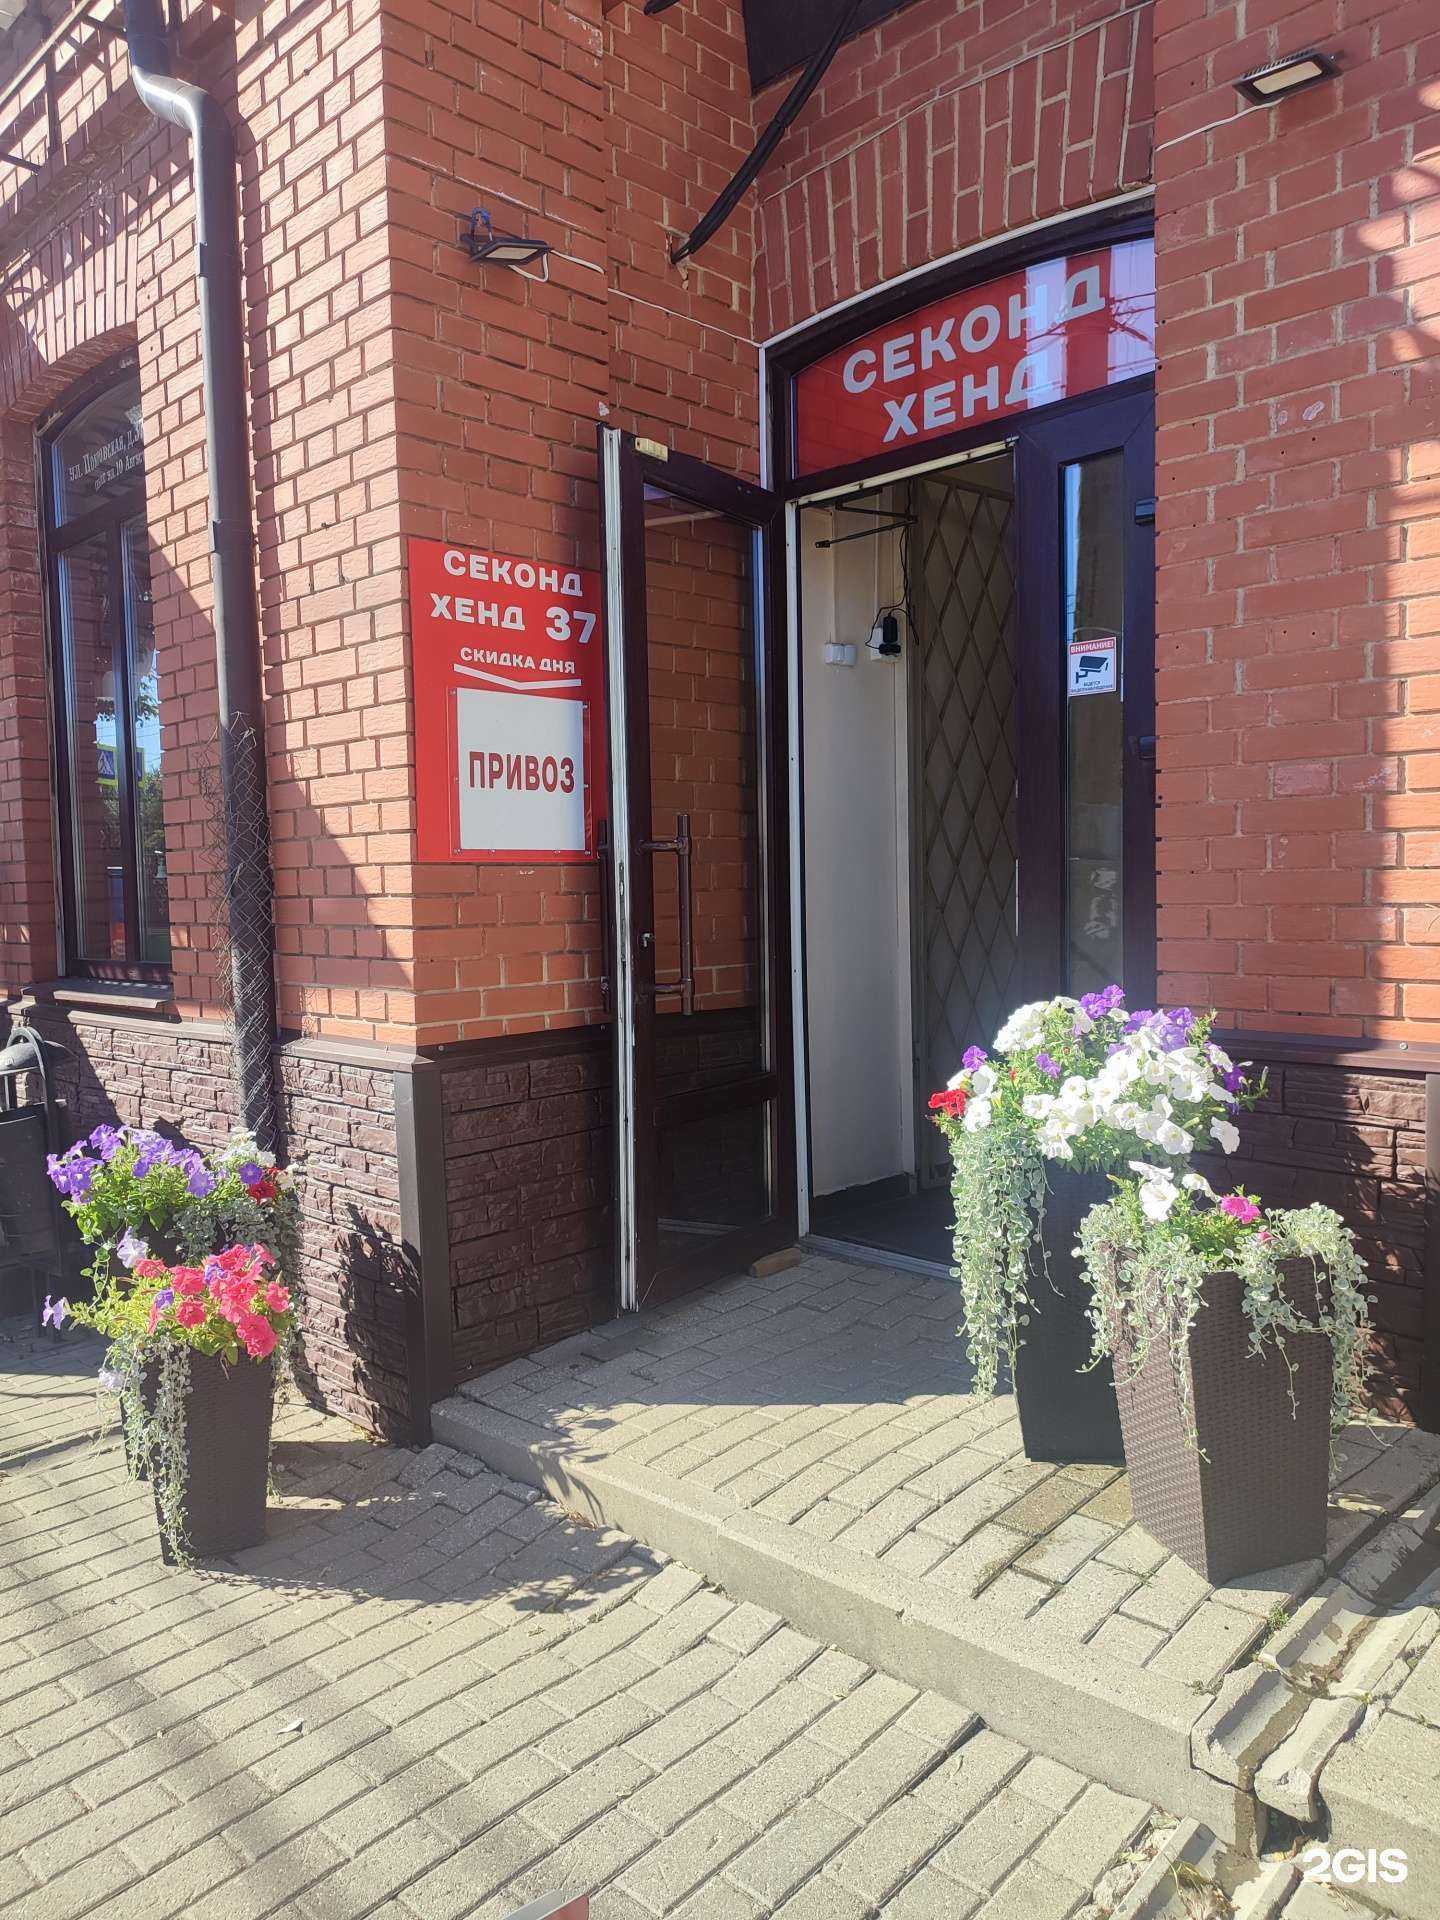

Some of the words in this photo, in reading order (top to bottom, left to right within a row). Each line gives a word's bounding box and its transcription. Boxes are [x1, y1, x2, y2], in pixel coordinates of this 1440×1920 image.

[843, 265, 1105, 394] СЕКОНД
[883, 352, 1050, 443] ХЕНД
[443, 550, 583, 597] СЕКОНД
[430, 592, 525, 631] ХЕНД
[546, 606, 597, 644] 37
[460, 647, 536, 669] СКИДКА
[539, 658, 575, 674] ДНЯ
[469, 751, 575, 794] ПРИВОЗ
